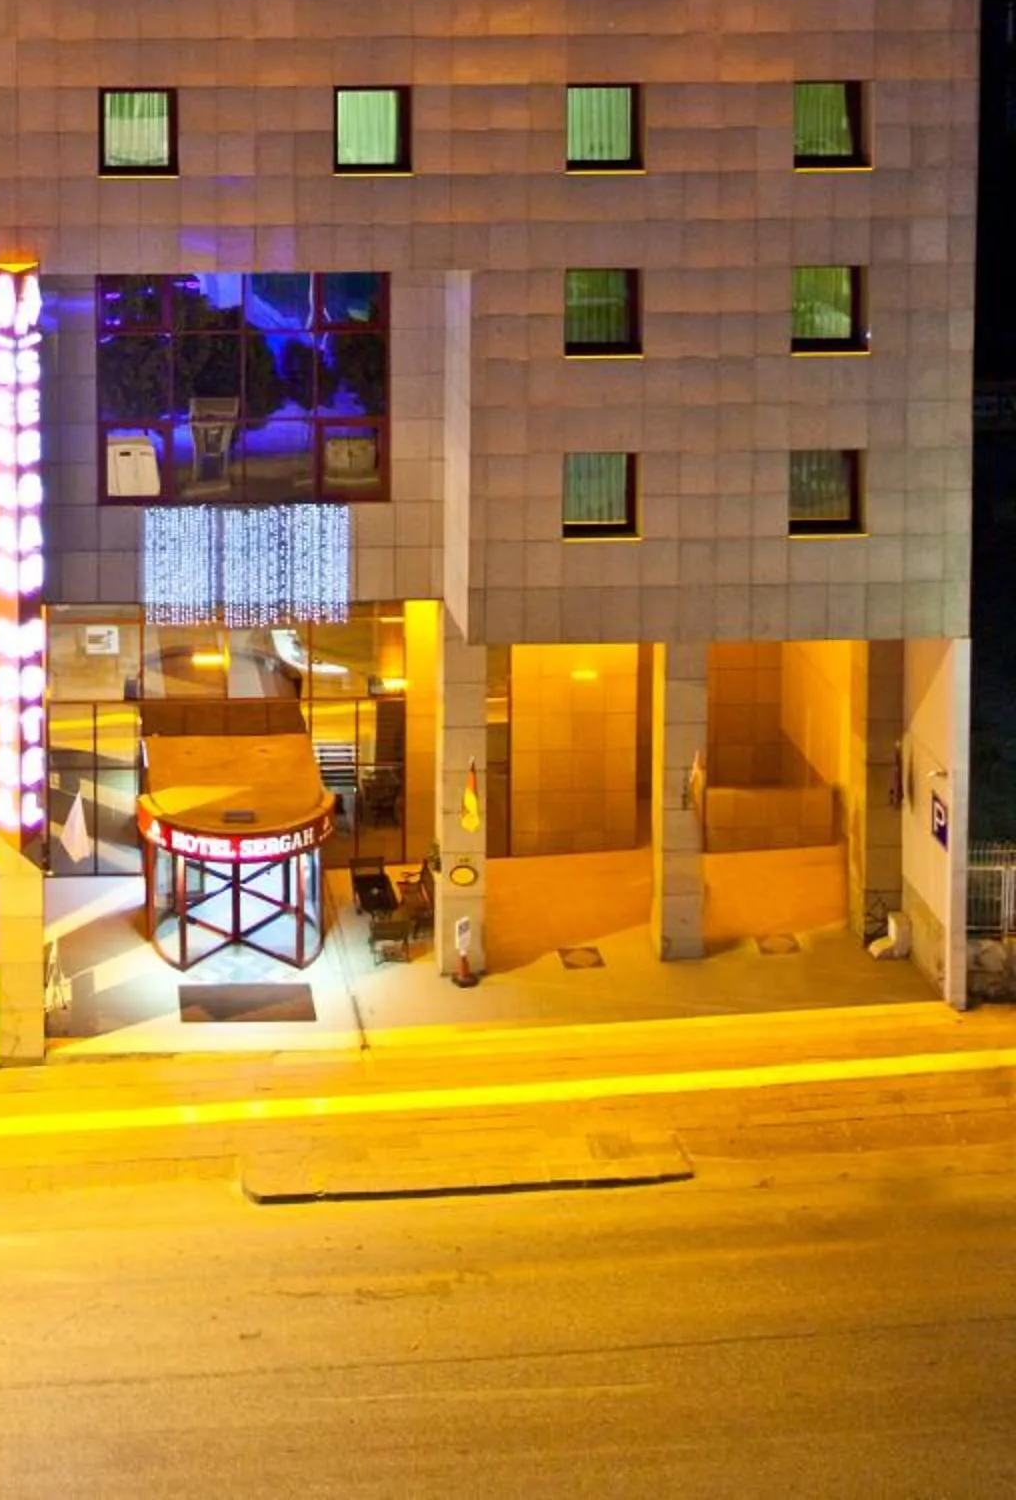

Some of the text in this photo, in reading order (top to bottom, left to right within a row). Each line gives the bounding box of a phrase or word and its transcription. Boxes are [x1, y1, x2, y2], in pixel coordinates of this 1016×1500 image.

[933, 801, 945, 832] P
[171, 827, 314, 857] HOTEL SERGAH
